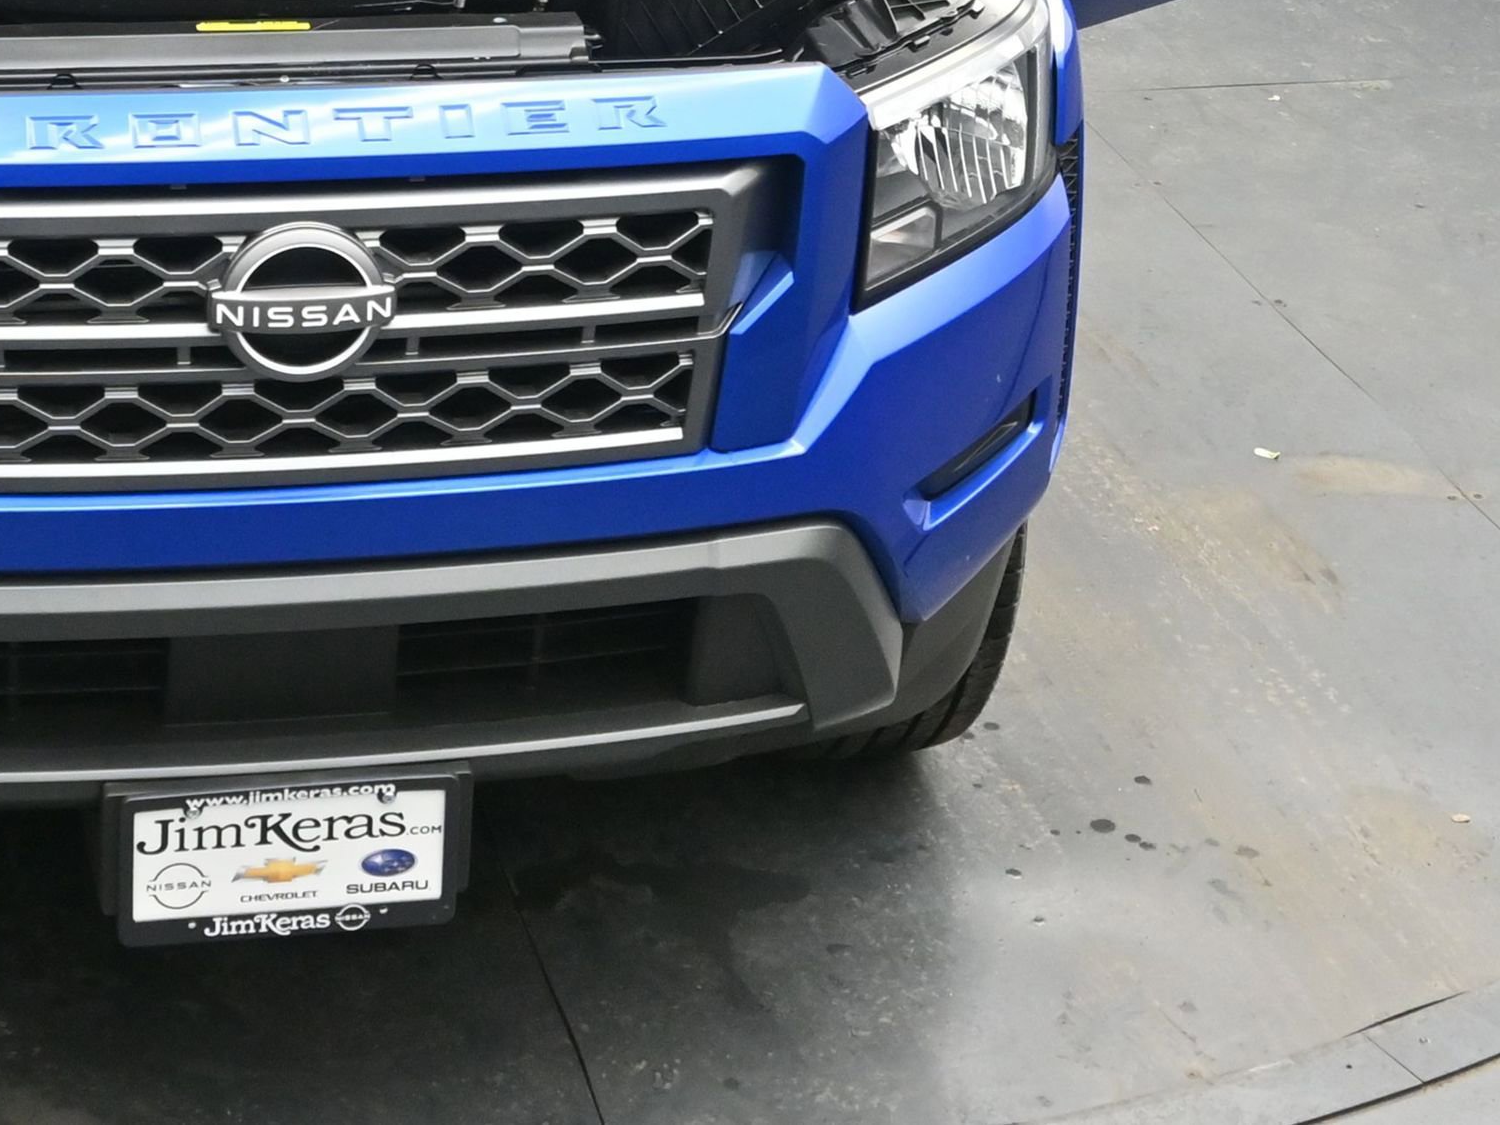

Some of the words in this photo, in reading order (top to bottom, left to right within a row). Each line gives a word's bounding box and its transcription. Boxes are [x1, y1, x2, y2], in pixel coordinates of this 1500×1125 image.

[216, 296, 392, 328] NISSAN
[185, 782, 397, 809] www.jimkeras.com
[146, 879, 212, 893] NISSAN
[345, 879, 430, 895] SUBARU
[239, 889, 318, 904] CHEVROLET
